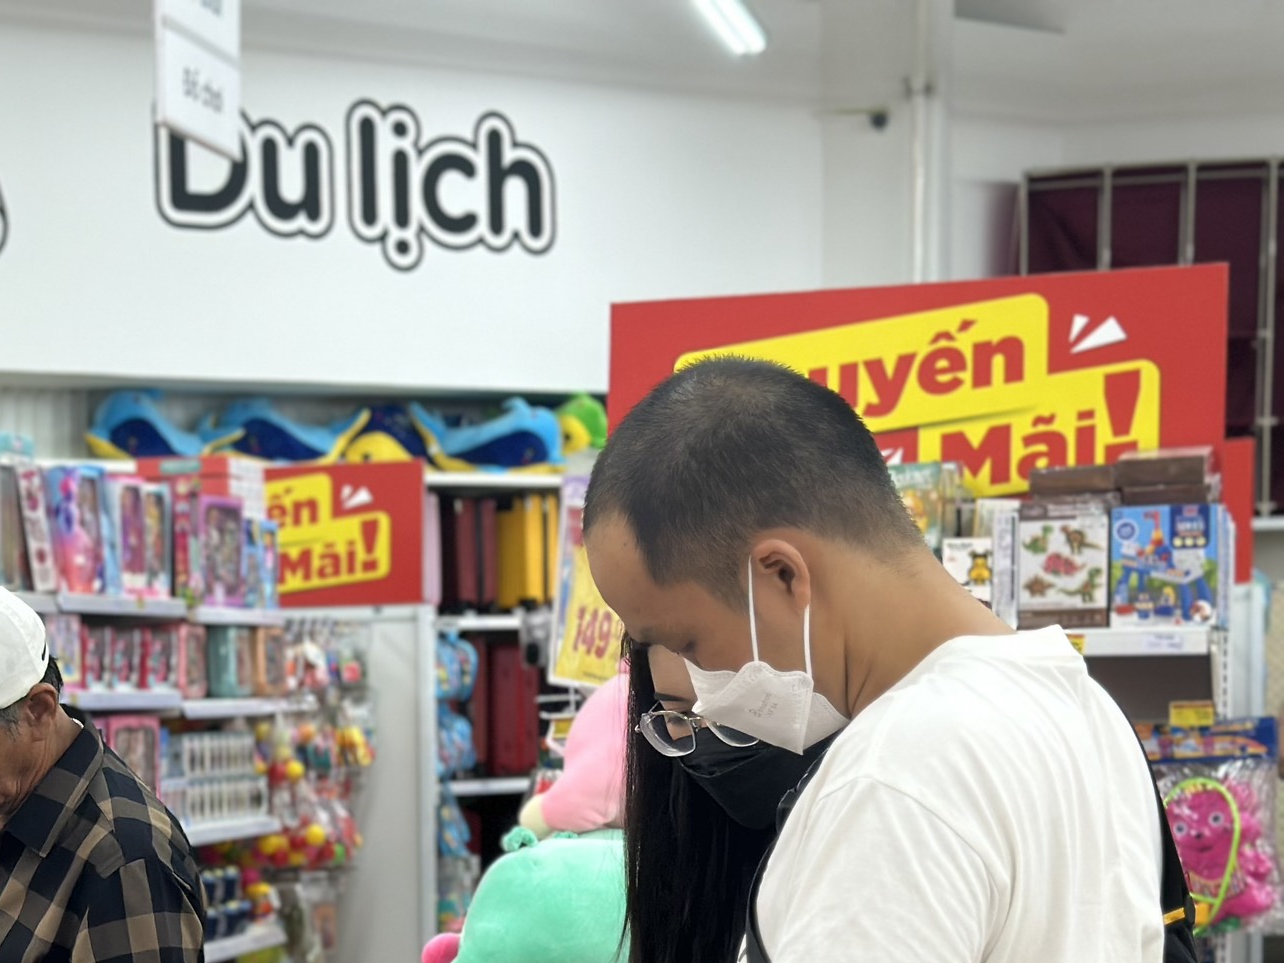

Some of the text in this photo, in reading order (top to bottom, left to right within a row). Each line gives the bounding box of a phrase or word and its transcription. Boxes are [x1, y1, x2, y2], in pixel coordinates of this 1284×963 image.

[163, 107, 549, 263] Du lịch
[809, 319, 1025, 418] uyến
[279, 518, 379, 585] Mãi!
